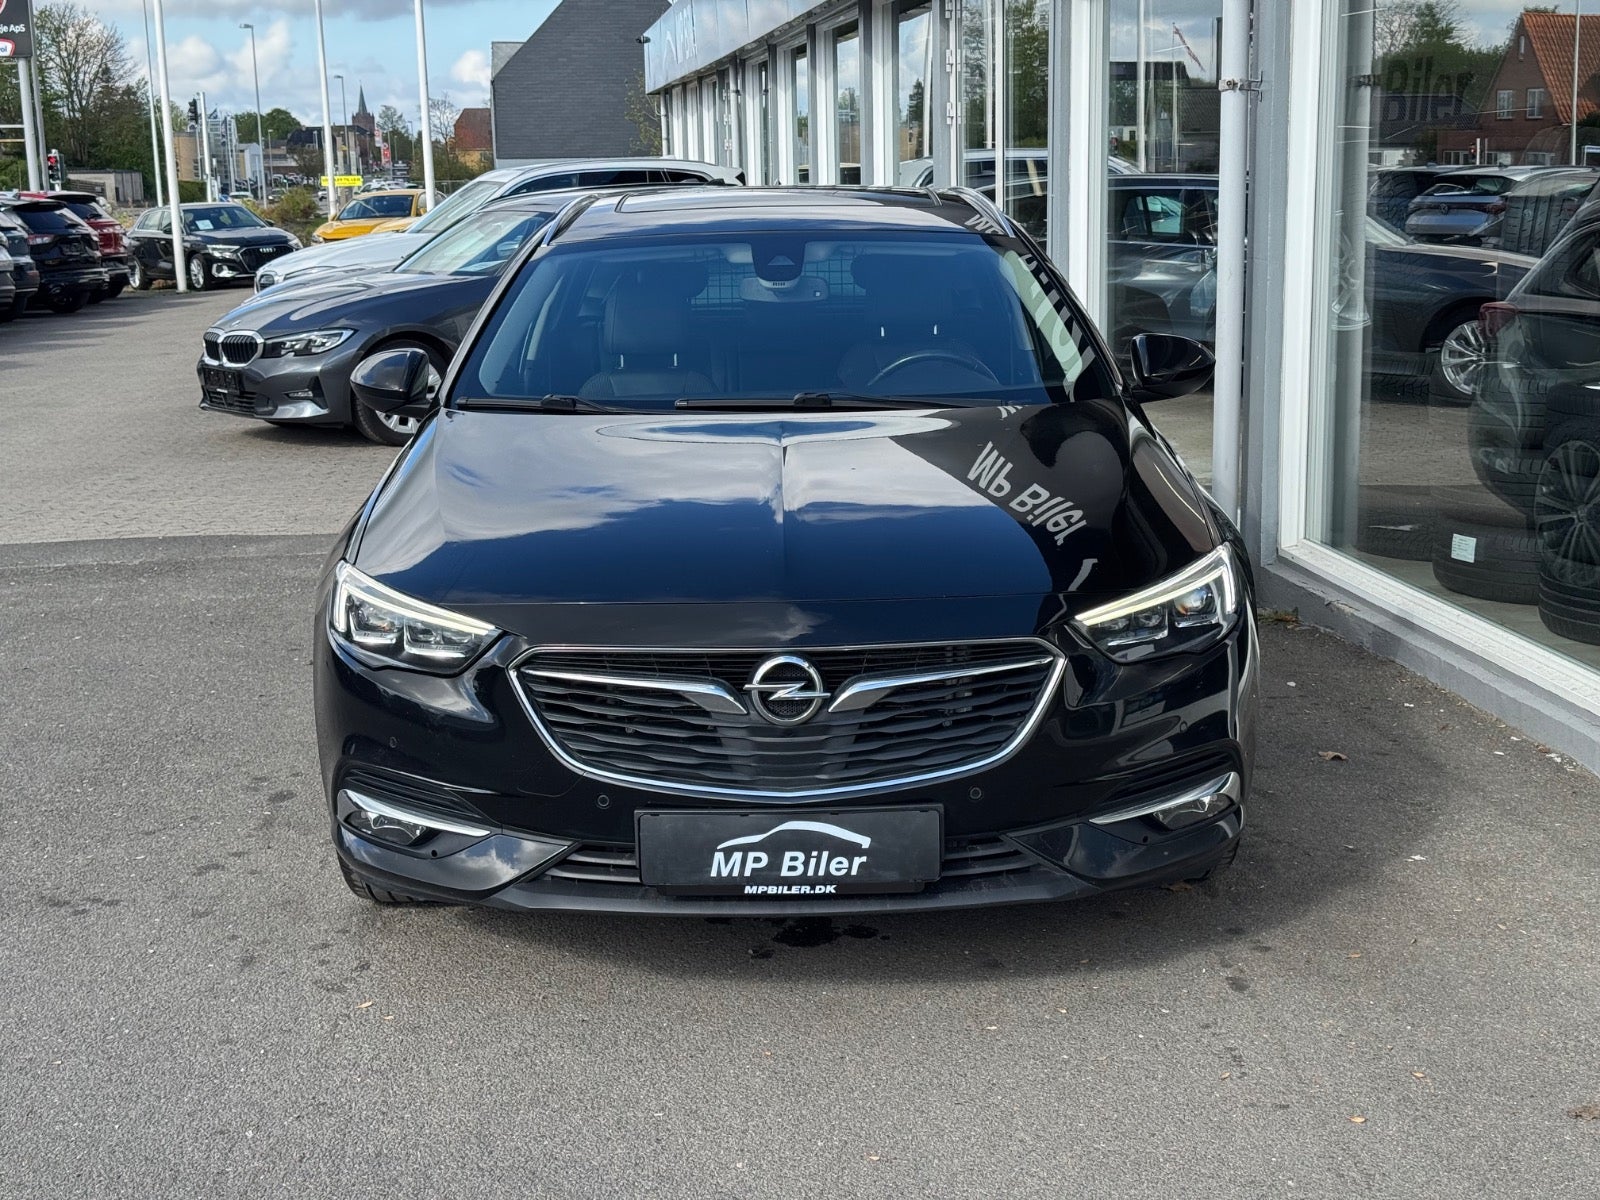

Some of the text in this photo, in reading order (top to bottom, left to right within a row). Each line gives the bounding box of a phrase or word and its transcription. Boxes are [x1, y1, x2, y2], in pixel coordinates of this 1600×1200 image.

[9, 23, 26, 33] ApS
[710, 850, 868, 877] MP Biler
[744, 883, 837, 895] MPBILER.DK
